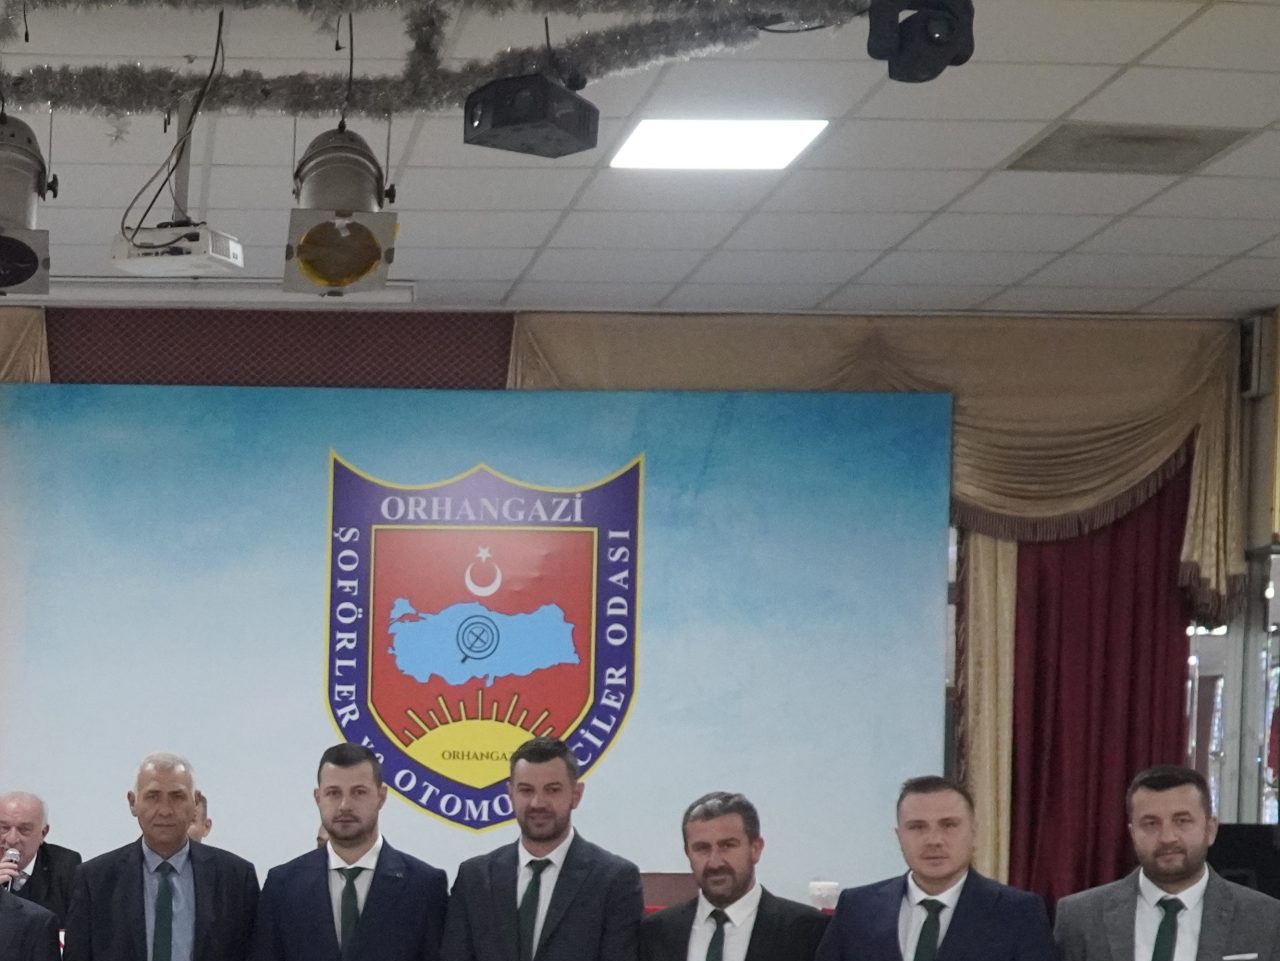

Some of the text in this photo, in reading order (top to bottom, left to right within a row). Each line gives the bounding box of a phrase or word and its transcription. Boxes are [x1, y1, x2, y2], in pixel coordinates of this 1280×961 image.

[380, 492, 584, 522] ORHANGAZİ
[333, 527, 362, 728] ŞOFÖRLER
[607, 530, 631, 646] ODASI
